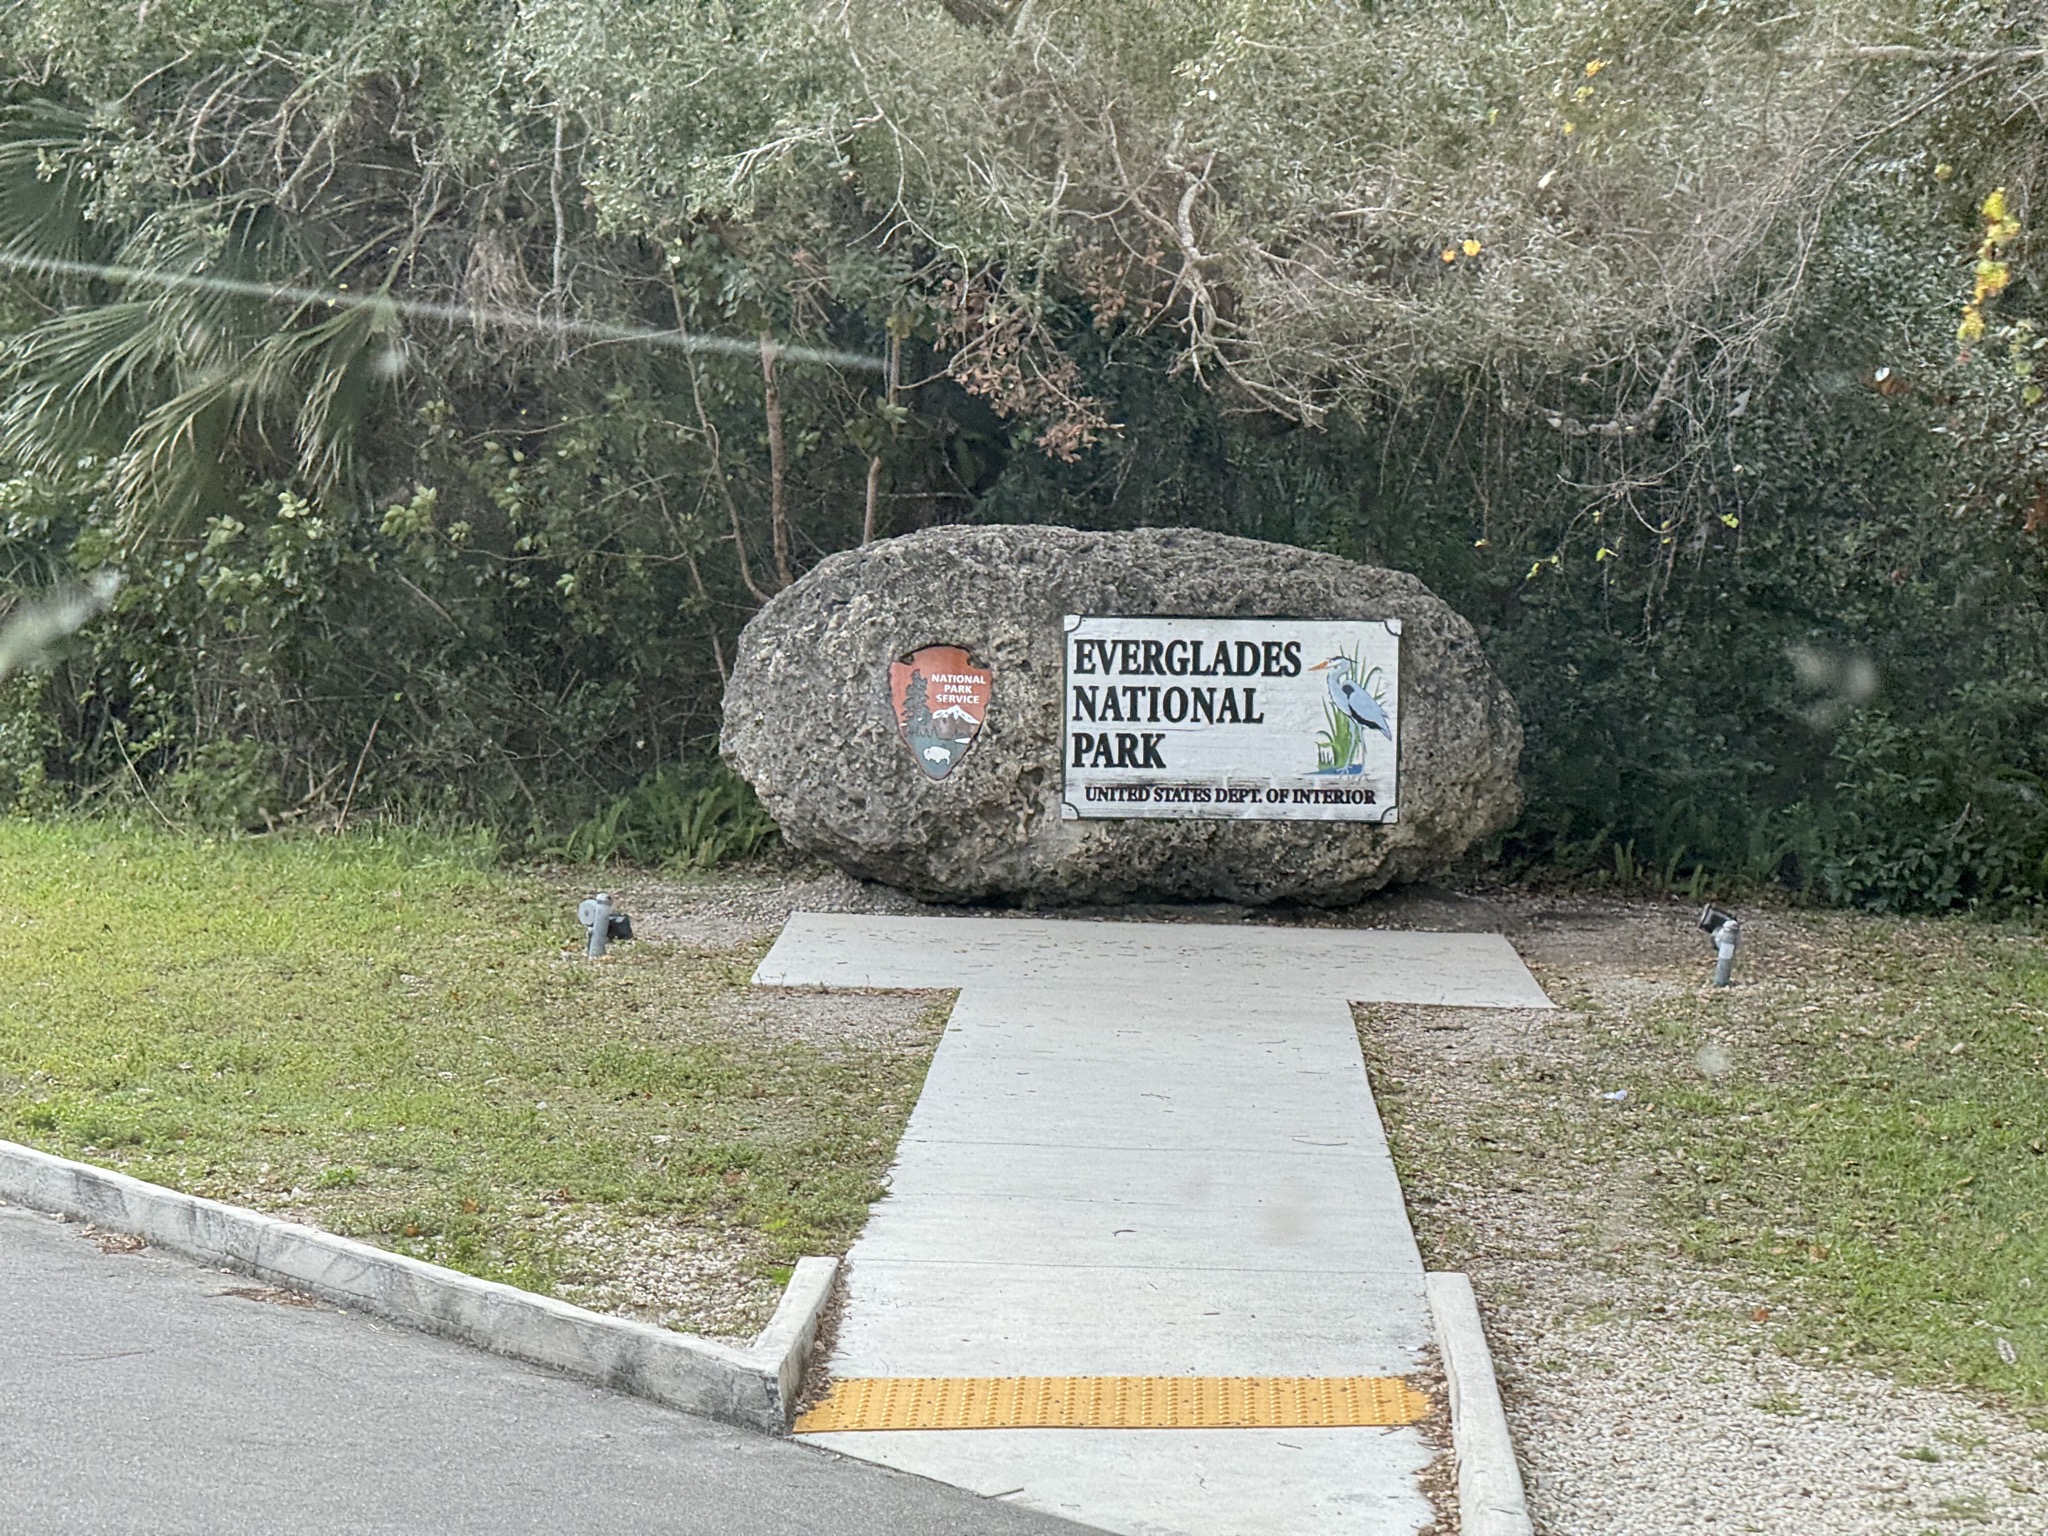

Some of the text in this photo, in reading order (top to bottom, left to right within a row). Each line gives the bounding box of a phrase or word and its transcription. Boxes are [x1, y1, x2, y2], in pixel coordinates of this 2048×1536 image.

[1073, 639, 1302, 678] EVERGLADES
[931, 674, 987, 684] NATIONAL
[944, 685, 973, 693] PARK
[935, 694, 980, 704] SERVICE
[1072, 685, 1264, 725] NATIONAL
[1071, 732, 1167, 769] PARK
[1085, 786, 1377, 805] UNITED STATES DEPT. OF INTERIOR
